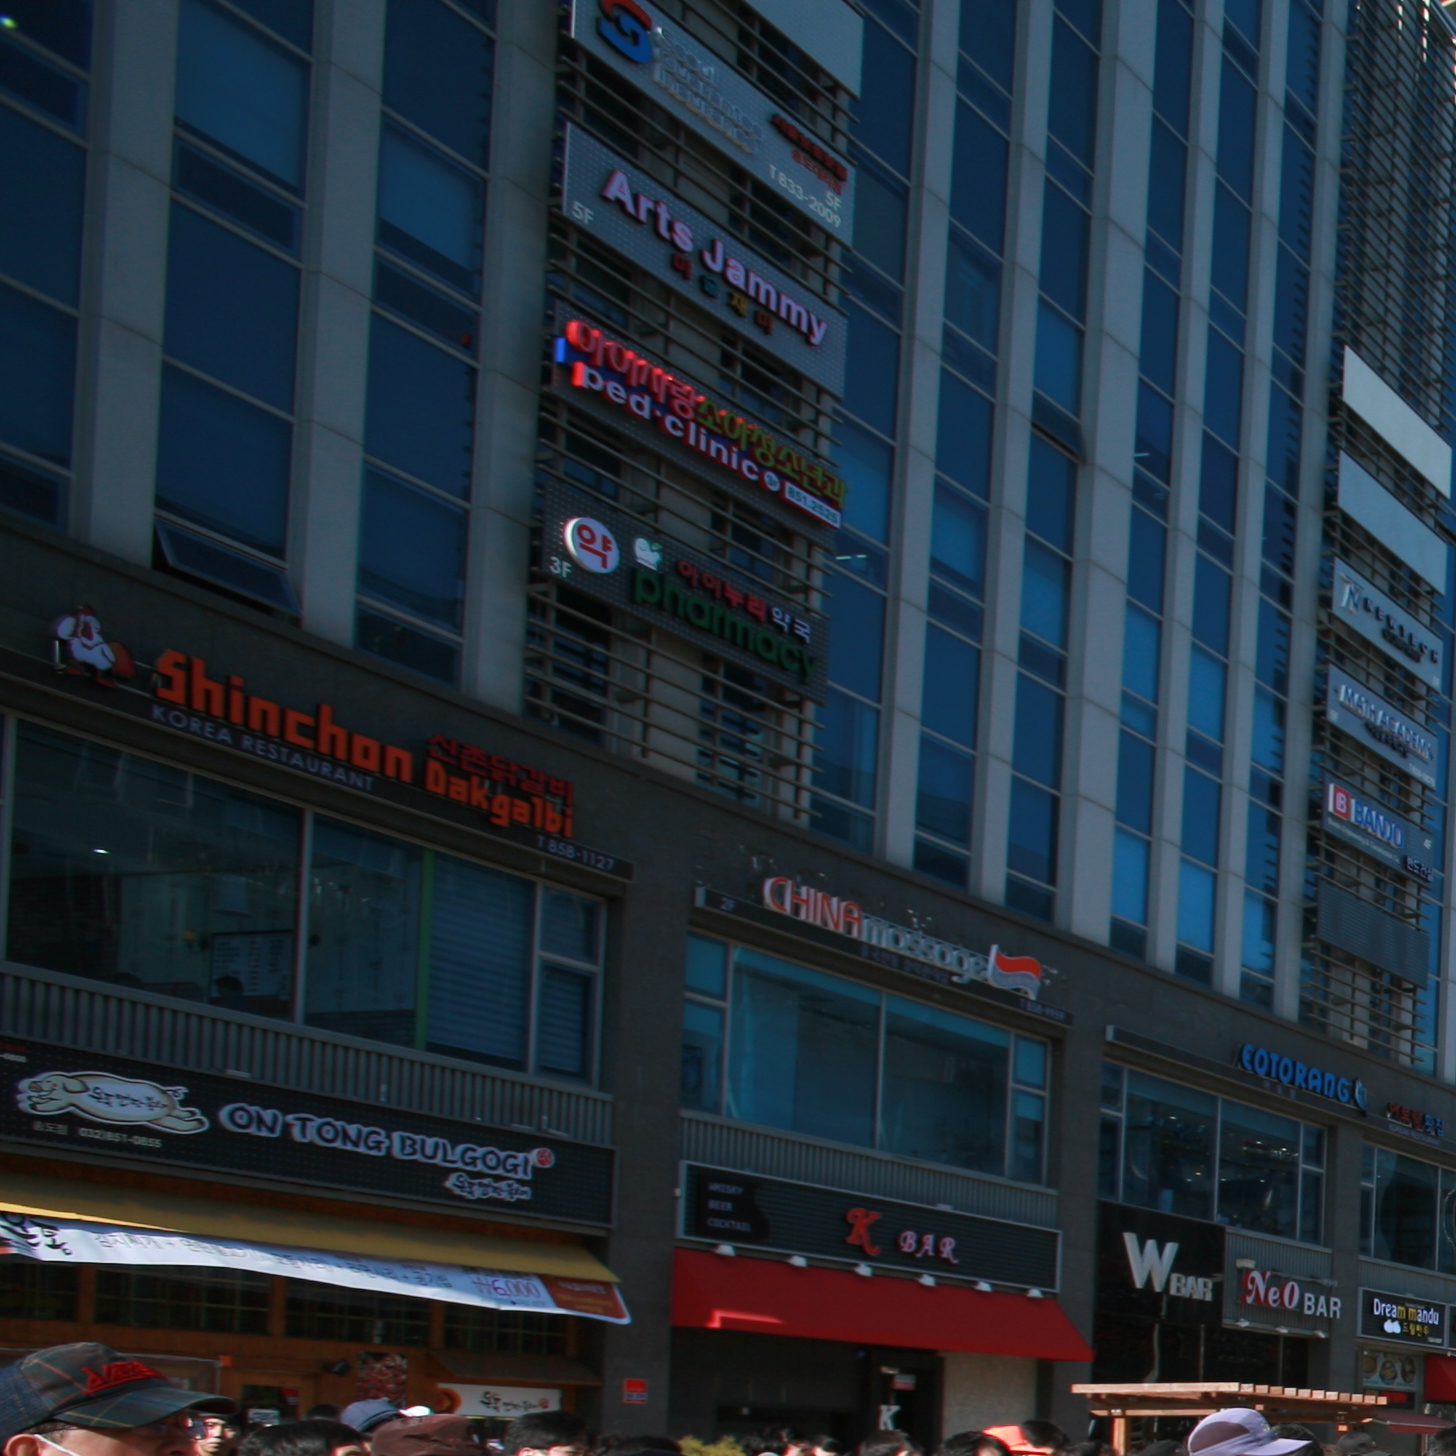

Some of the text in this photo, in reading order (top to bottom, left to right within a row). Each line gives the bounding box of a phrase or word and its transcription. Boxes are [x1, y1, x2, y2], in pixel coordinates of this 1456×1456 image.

[572, 202, 594, 225] 5F
[777, 173, 841, 228] 833-2009
[602, 169, 828, 346] Arts Jammy
[550, 556, 572, 578] 3F
[576, 523, 615, 569] 약
[634, 571, 820, 684] pharmacy
[677, 559, 812, 644] 아이누리 약국
[155, 648, 412, 784] Shinchon
[152, 704, 375, 792] KOREA RESTAURANT
[427, 733, 575, 808] 신촌닭갈비
[425, 759, 574, 838] Dakgalbi
[1351, 798, 1405, 848] BANDO
[536, 835, 616, 871] T 858-1127
[763, 877, 863, 938] CHINA
[1239, 1043, 1349, 1100] EOTORANG
[220, 1102, 534, 1181] ON TONG BULGOGI
[708, 1180, 743, 1195] WHISKY
[708, 1200, 733, 1213] BEER
[706, 1217, 752, 1233] COCKTAIL
[845, 1207, 960, 1264] K BAR
[1122, 1231, 1213, 1302] W BAR
[1303, 1292, 1341, 1319] BAR
[1372, 1299, 1440, 1326] Dream mandu
